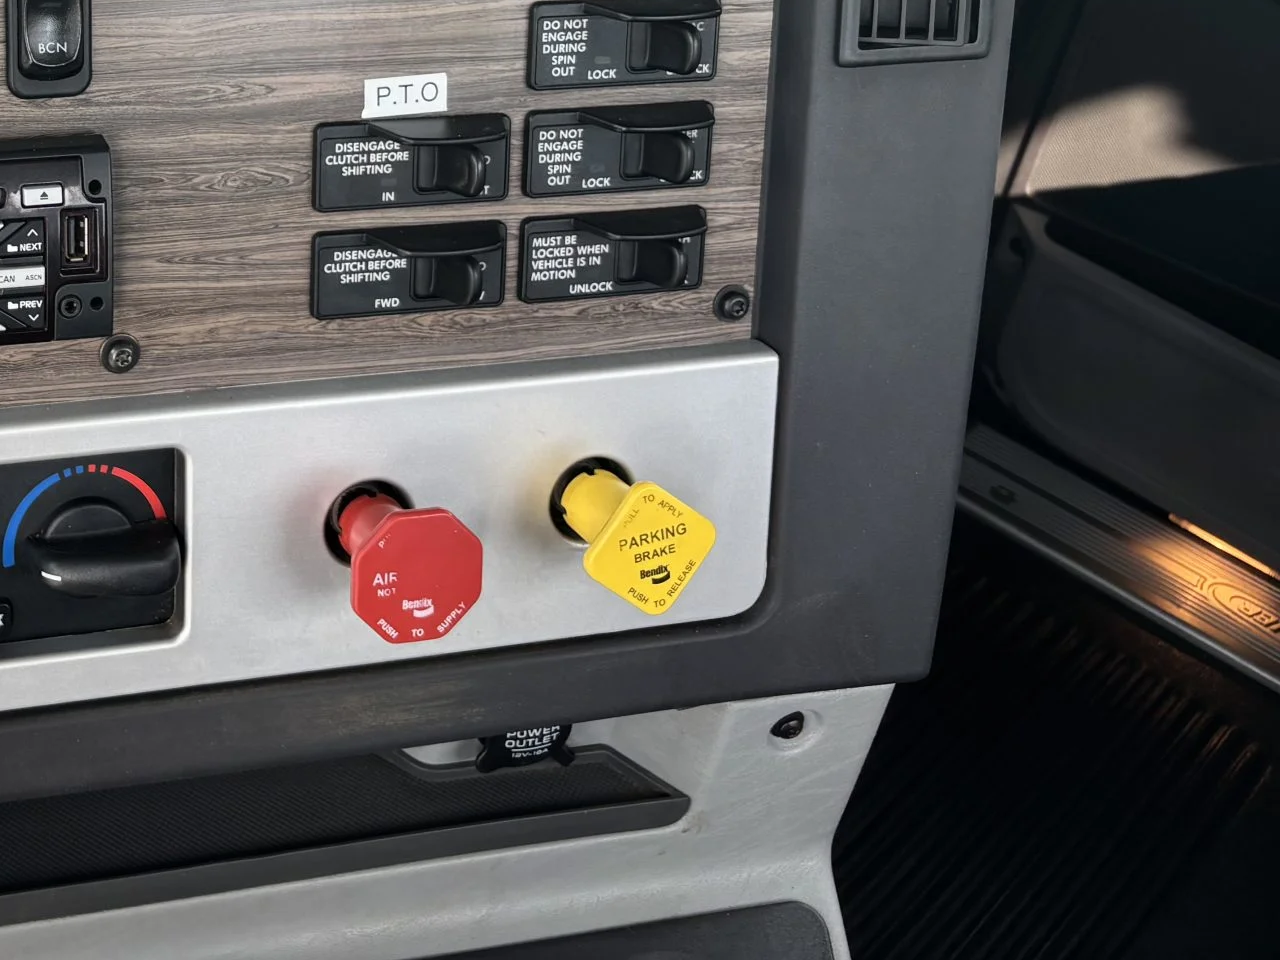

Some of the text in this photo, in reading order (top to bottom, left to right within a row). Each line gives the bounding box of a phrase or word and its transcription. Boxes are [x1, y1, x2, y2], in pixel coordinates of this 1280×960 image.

[543, 18, 589, 31] DO NOT
[541, 30, 589, 43] ENGAGE
[38, 41, 68, 54] BCN
[542, 42, 587, 54] DURING
[551, 54, 576, 66] SPIN
[551, 66, 576, 78] OUT
[587, 68, 617, 81] LOCK
[376, 81, 439, 107] P.T.O
[539, 129, 584, 141] DO NOT
[335, 140, 401, 154] DISENGAGE
[537, 140, 584, 152] ENGAGE
[325, 151, 410, 166] CLUTCH BEFORE
[538, 152, 582, 164] DURING
[341, 164, 393, 177] SHIFTING
[547, 163, 572, 175] SPIN
[547, 175, 571, 186] OUT
[582, 176, 611, 189] LOCK
[381, 192, 395, 202] IN
[20, 242, 43, 252] NEXT
[532, 235, 577, 247] MUST BE
[532, 243, 610, 259] LOCKED WHEN
[324, 259, 408, 274] CLUTCH BEFORE
[531, 256, 601, 270] VEHICLE IS IN
[24, 272, 43, 281] ASCN
[340, 271, 391, 284] SHIFTING
[531, 268, 576, 281] MOTION
[569, 281, 613, 294] UNLOCK
[19, 299, 43, 310] PREV
[374, 297, 400, 309] FWD
[642, 494, 684, 519] TO APPLY
[619, 523, 687, 552] PARKING
[634, 544, 676, 564] BRAKE
[640, 564, 669, 580] Bendix
[627, 559, 697, 608] PUSH TO RELEASE
[402, 598, 433, 611] Bendix
[377, 601, 467, 639] PUSH TO SUPPLY
[504, 731, 560, 748] OUTLET
